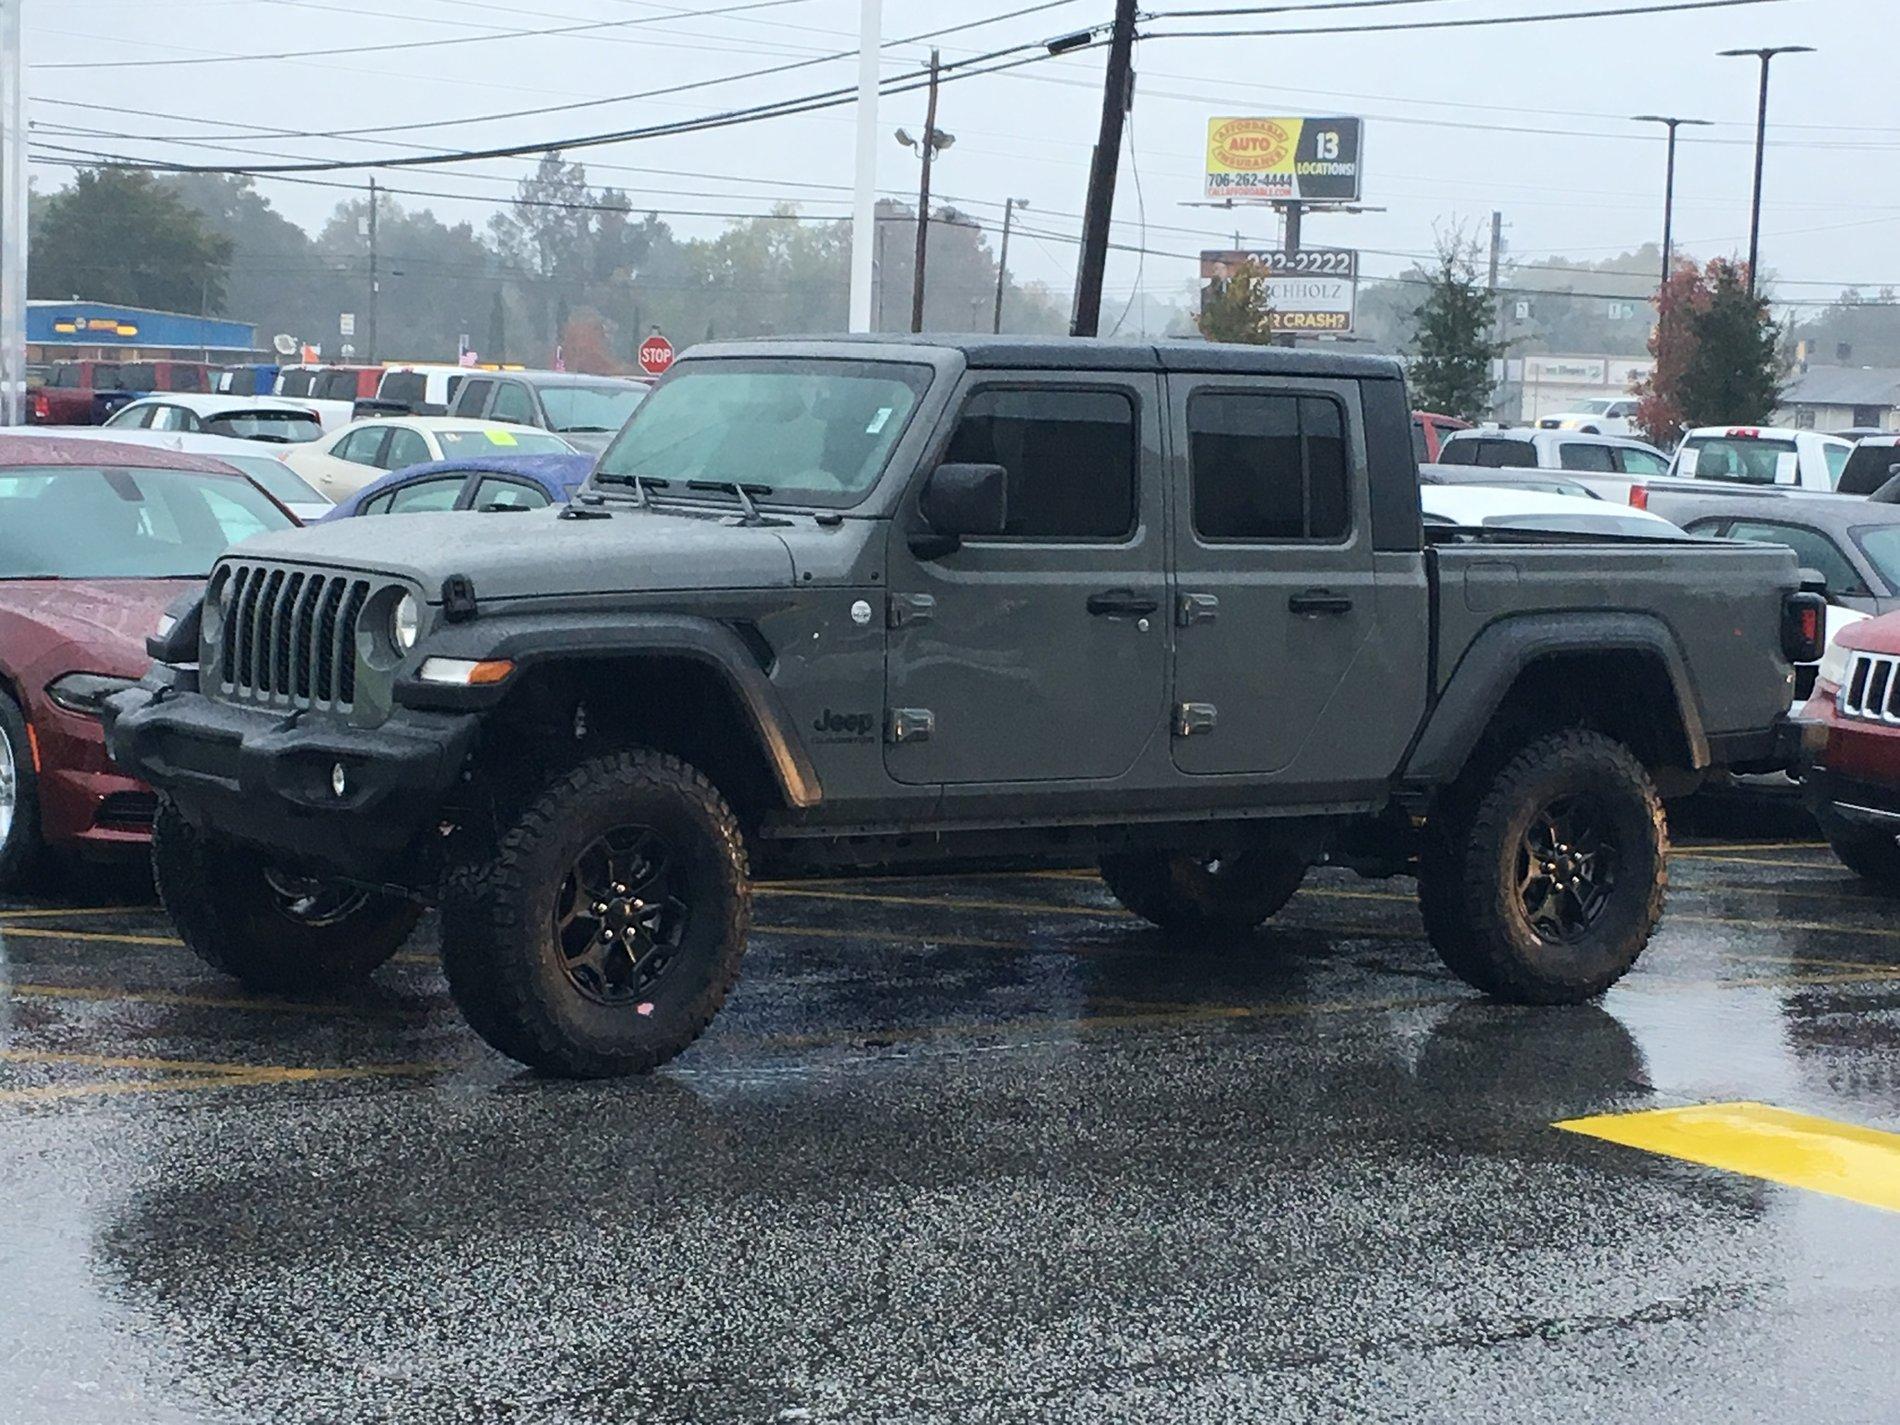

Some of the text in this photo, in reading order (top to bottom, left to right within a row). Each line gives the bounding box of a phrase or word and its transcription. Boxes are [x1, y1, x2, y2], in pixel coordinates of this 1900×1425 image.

[1218, 121, 1285, 140] AFFORDABLE
[1229, 136, 1271, 152] AUTO
[1316, 131, 1340, 160] 13
[1216, 150, 1283, 168] INSURANCE
[1296, 161, 1355, 176] LOCATIONS!
[1207, 172, 1292, 188] 706-262-4444
[1268, 283, 1342, 299] CHHOLZ
[1283, 312, 1346, 328] CRASH?
[641, 347, 672, 364] STOP
[812, 708, 874, 736] Jeep
